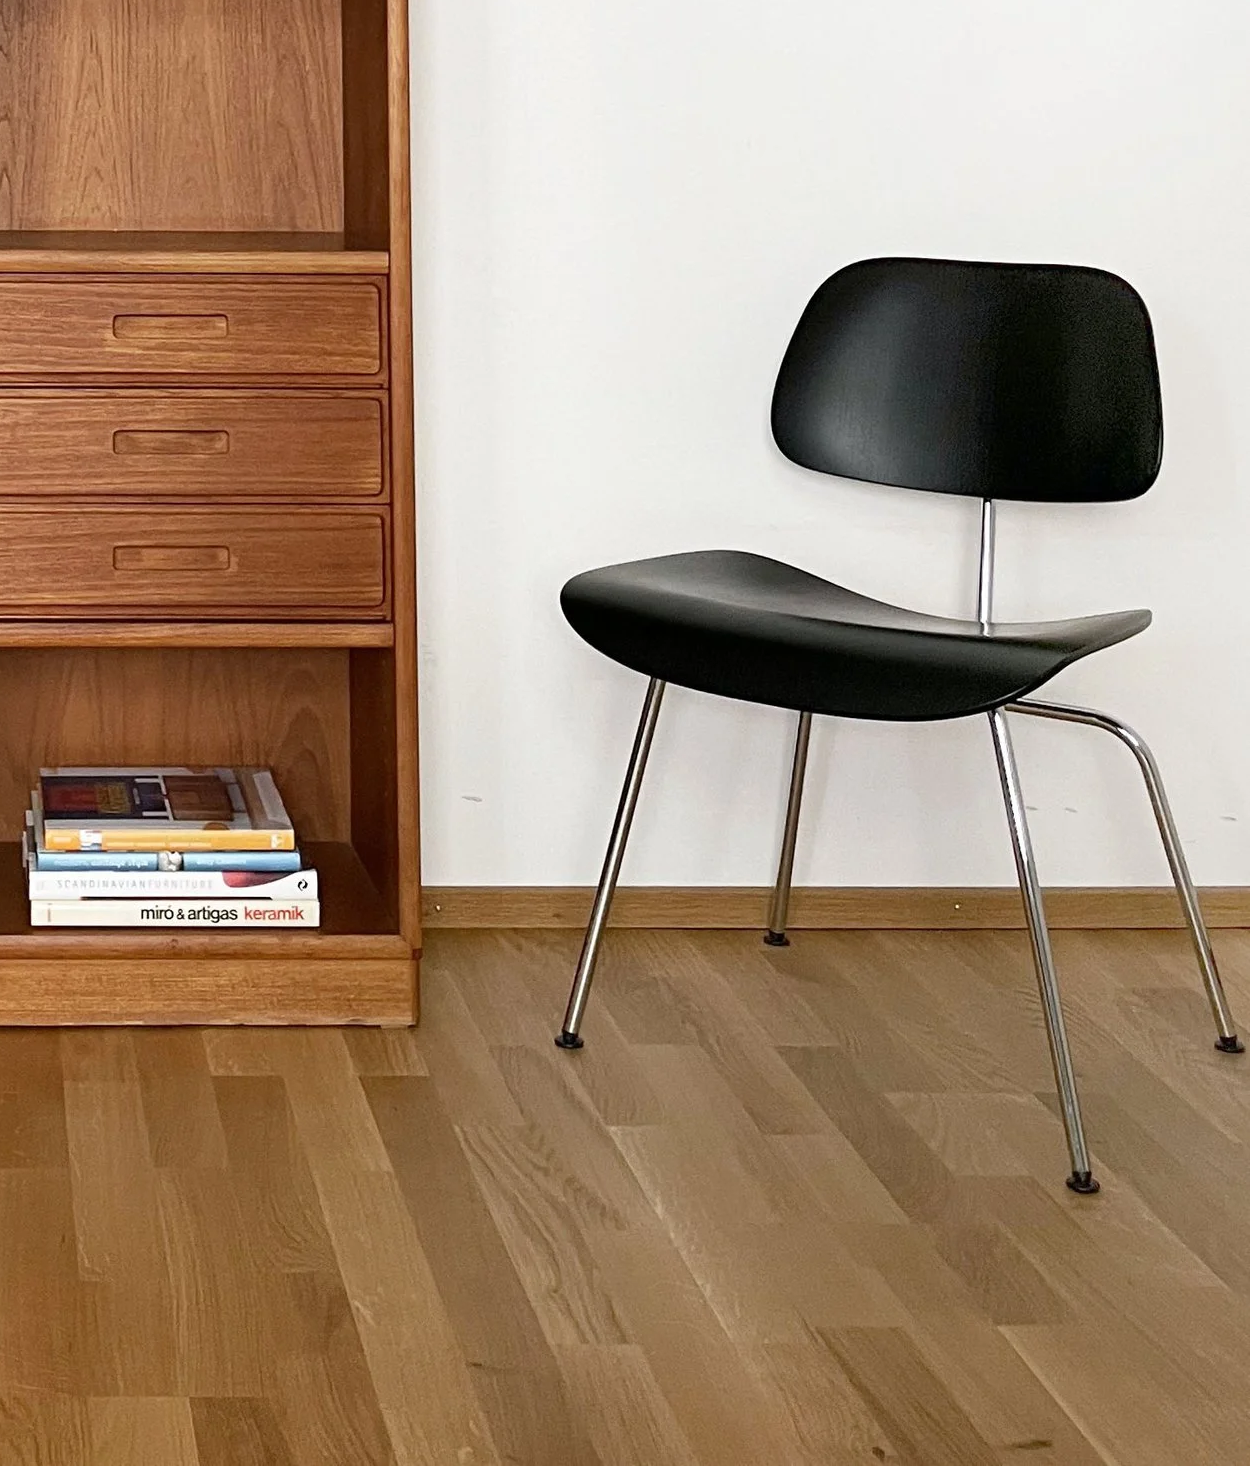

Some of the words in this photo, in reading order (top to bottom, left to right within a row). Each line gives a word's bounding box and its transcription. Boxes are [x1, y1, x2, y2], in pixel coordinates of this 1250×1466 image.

[141, 905, 174, 920] miró
[177, 909, 186, 920] &
[188, 906, 239, 923] artigas
[245, 906, 305, 920] keramik
